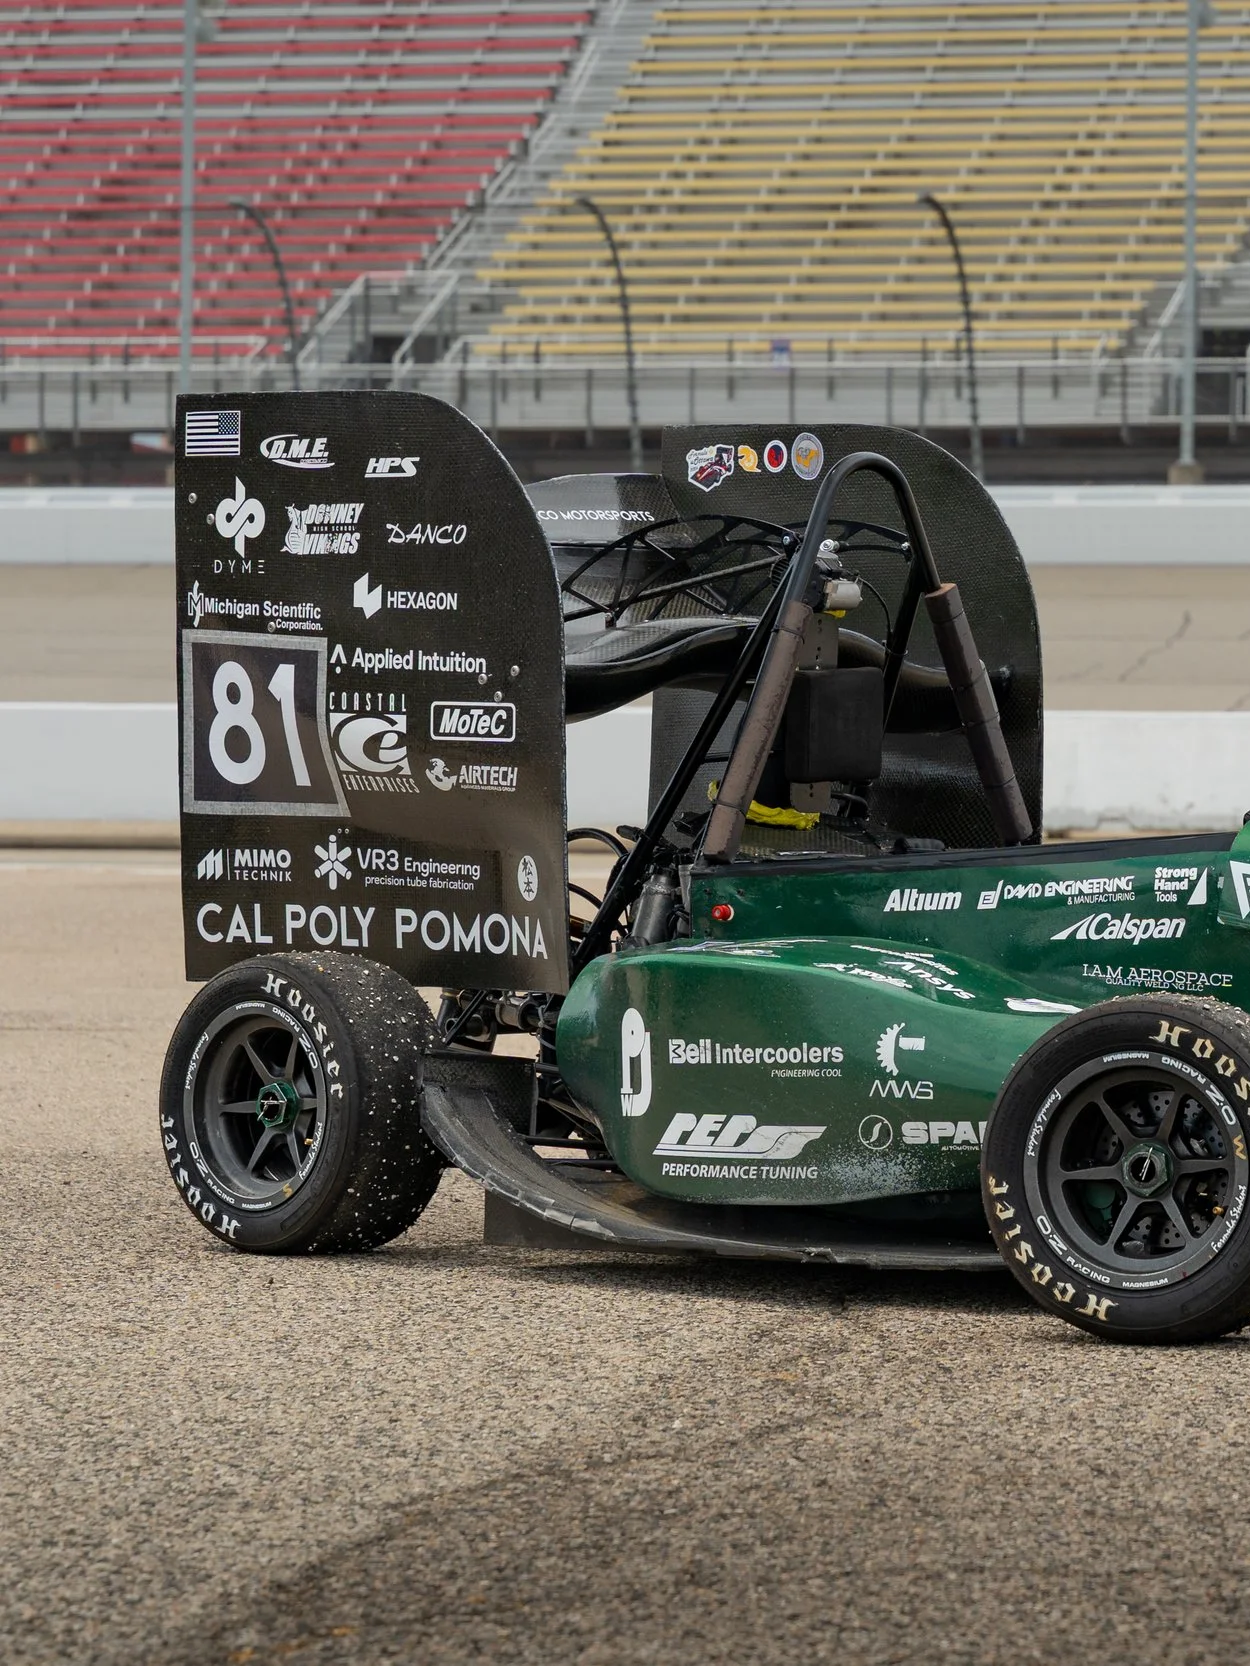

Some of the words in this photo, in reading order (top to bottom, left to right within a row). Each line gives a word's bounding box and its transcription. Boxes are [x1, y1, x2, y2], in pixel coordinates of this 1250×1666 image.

[268, 438, 329, 459] D.M.E.
[366, 456, 420, 477] HPS
[305, 503, 364, 524] DOWNEY
[560, 510, 655, 521] MOTORSPORTS
[303, 532, 360, 554] VIKINGS
[385, 522, 467, 545] DANCO
[213, 559, 265, 574] DYME
[204, 598, 260, 618] Michigan
[263, 600, 321, 620] Scientific
[387, 590, 457, 611] HEXAGON
[276, 618, 323, 631] Corporation.
[352, 647, 413, 673] Applied
[417, 650, 487, 674] Intuition
[329, 692, 407, 712] COASTAL
[208, 660, 311, 786] 81
[439, 708, 507, 736] MoTeC
[342, 774, 420, 794] ENTERPRISES
[459, 765, 518, 787] AIRTECH
[234, 849, 292, 868] MIMO
[357, 847, 399, 871] VR3
[404, 857, 481, 880] Engineering
[234, 870, 292, 882] TECHNIK
[365, 875, 405, 887] precision
[406, 876, 427, 888] tube
[429, 877, 474, 890] fabrication
[1154, 867, 1198, 881] Strong
[1154, 879, 1189, 891] Hand
[1003, 882, 1042, 900] DAVID
[1044, 876, 1136, 897] ENGINEERING
[1067, 896, 1074, 905] &
[1074, 892, 1136, 905] MANUFACTURING
[1155, 891, 1178, 903] Tools
[883, 889, 962, 912] Altium
[197, 902, 273, 944] CAL
[285, 904, 376, 948] POLY
[395, 907, 548, 960] POMONA
[1088, 913, 1186, 946] Calspan
[884, 961, 976, 1000] Ansys
[1083, 963, 1122, 980] I.A.M
[1127, 967, 1233, 987] AEROSPACE
[1105, 977, 1142, 988] QUALITY
[1143, 980, 1185, 991] WELDNG
[1187, 984, 1205, 992] LLC
[271, 1006, 301, 1033] RACING
[261, 973, 344, 1100] Hoosier
[668, 1038, 712, 1065] Bell
[715, 1042, 844, 1065] Intercoolers
[1102, 1053, 1150, 1063] MAGNESIUM
[821, 1068, 842, 1078] COOL
[1161, 1056, 1207, 1085] RACING
[869, 1080, 934, 1100] MWS
[1026, 1123, 1044, 1157] Student
[160, 1112, 243, 1239] Hoosier
[662, 1162, 757, 1178] PERFORMANCE
[761, 1166, 818, 1180] TUNING
[206, 1178, 236, 1204] RACING
[1230, 1184, 1247, 1220] Student
[988, 1175, 1119, 1321] Hoosier
[1066, 1256, 1111, 1284] RACING
[1122, 1278, 1169, 1289] MAGNESIUM
